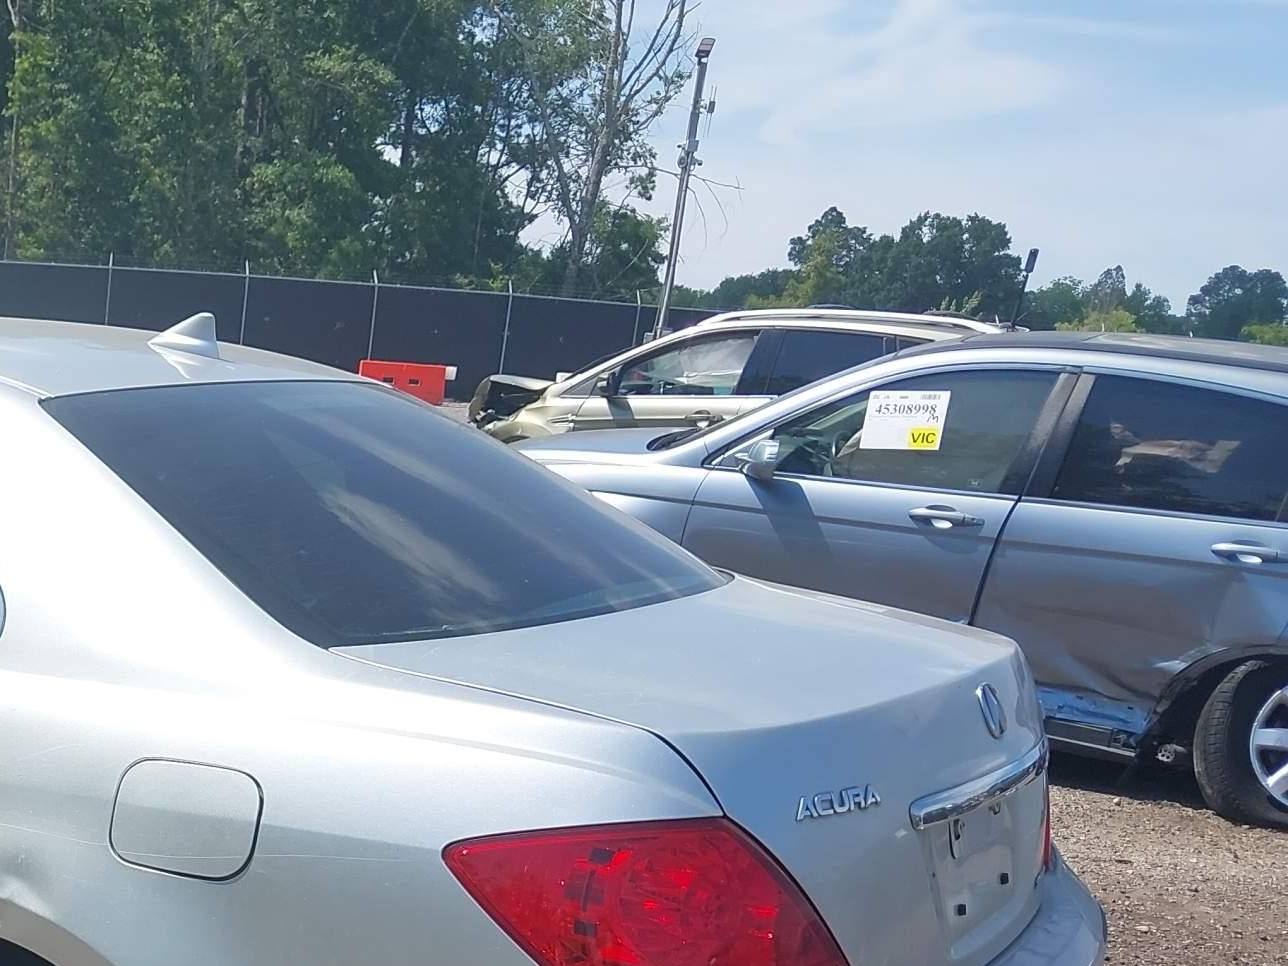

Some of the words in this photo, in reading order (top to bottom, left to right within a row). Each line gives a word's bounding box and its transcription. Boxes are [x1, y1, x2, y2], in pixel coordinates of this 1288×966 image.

[874, 403, 938, 416] 45308998
[911, 432, 937, 445] VIC
[795, 784, 881, 822] ACURA
